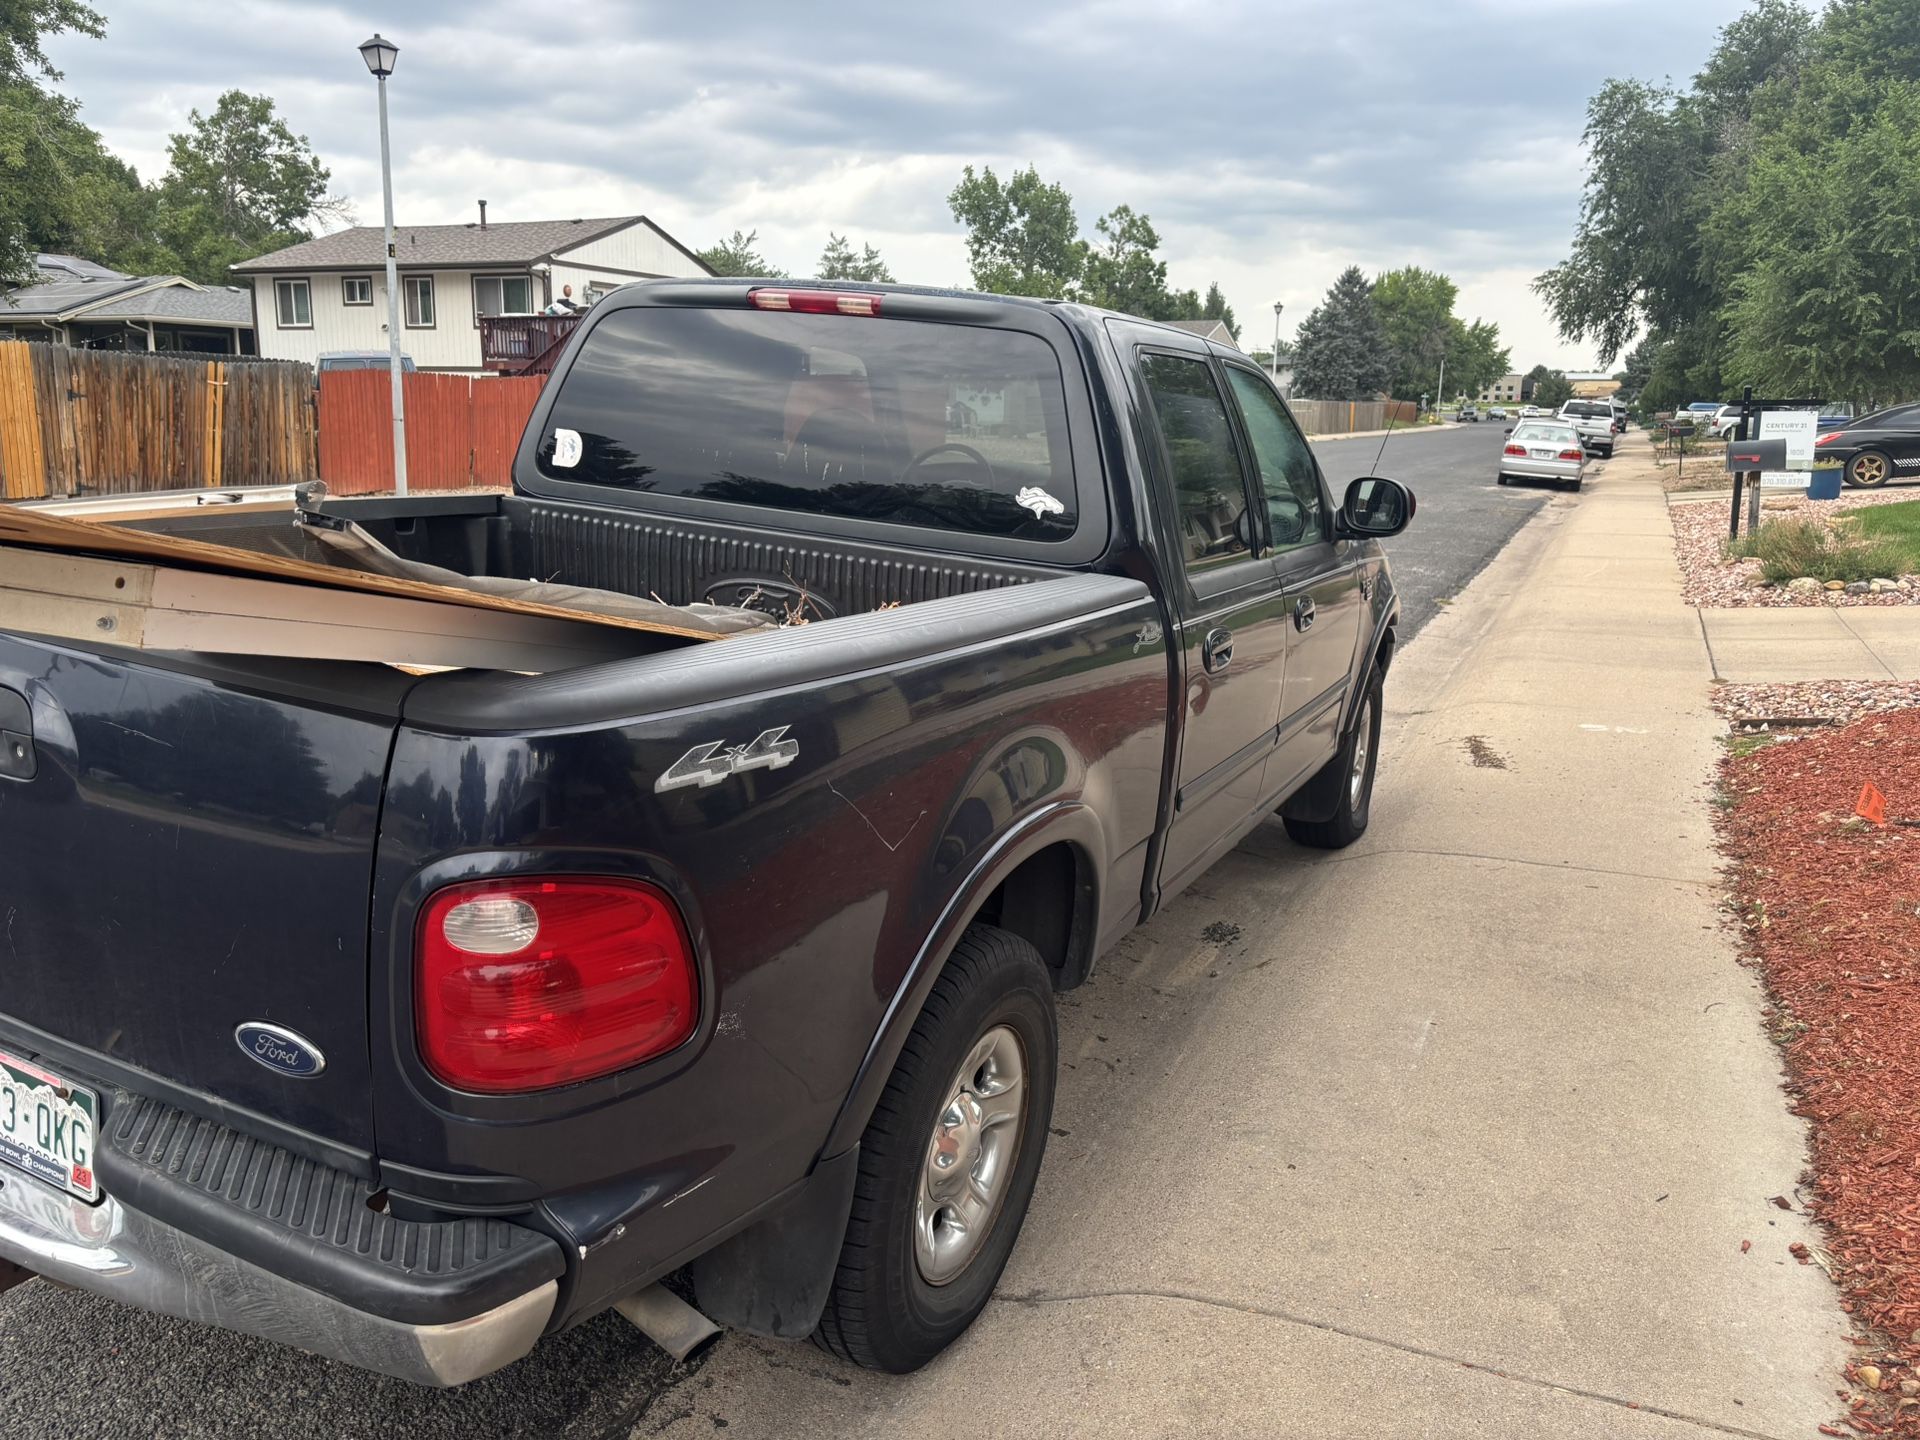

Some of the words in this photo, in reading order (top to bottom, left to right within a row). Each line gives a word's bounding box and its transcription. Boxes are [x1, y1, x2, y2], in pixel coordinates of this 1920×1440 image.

[255, 1033, 299, 1066] Ford
[5, 1147, 22, 1160] BOWL
[32, 1161, 65, 1181] CHAMPIONS
[76, 1168, 87, 1183] 23
